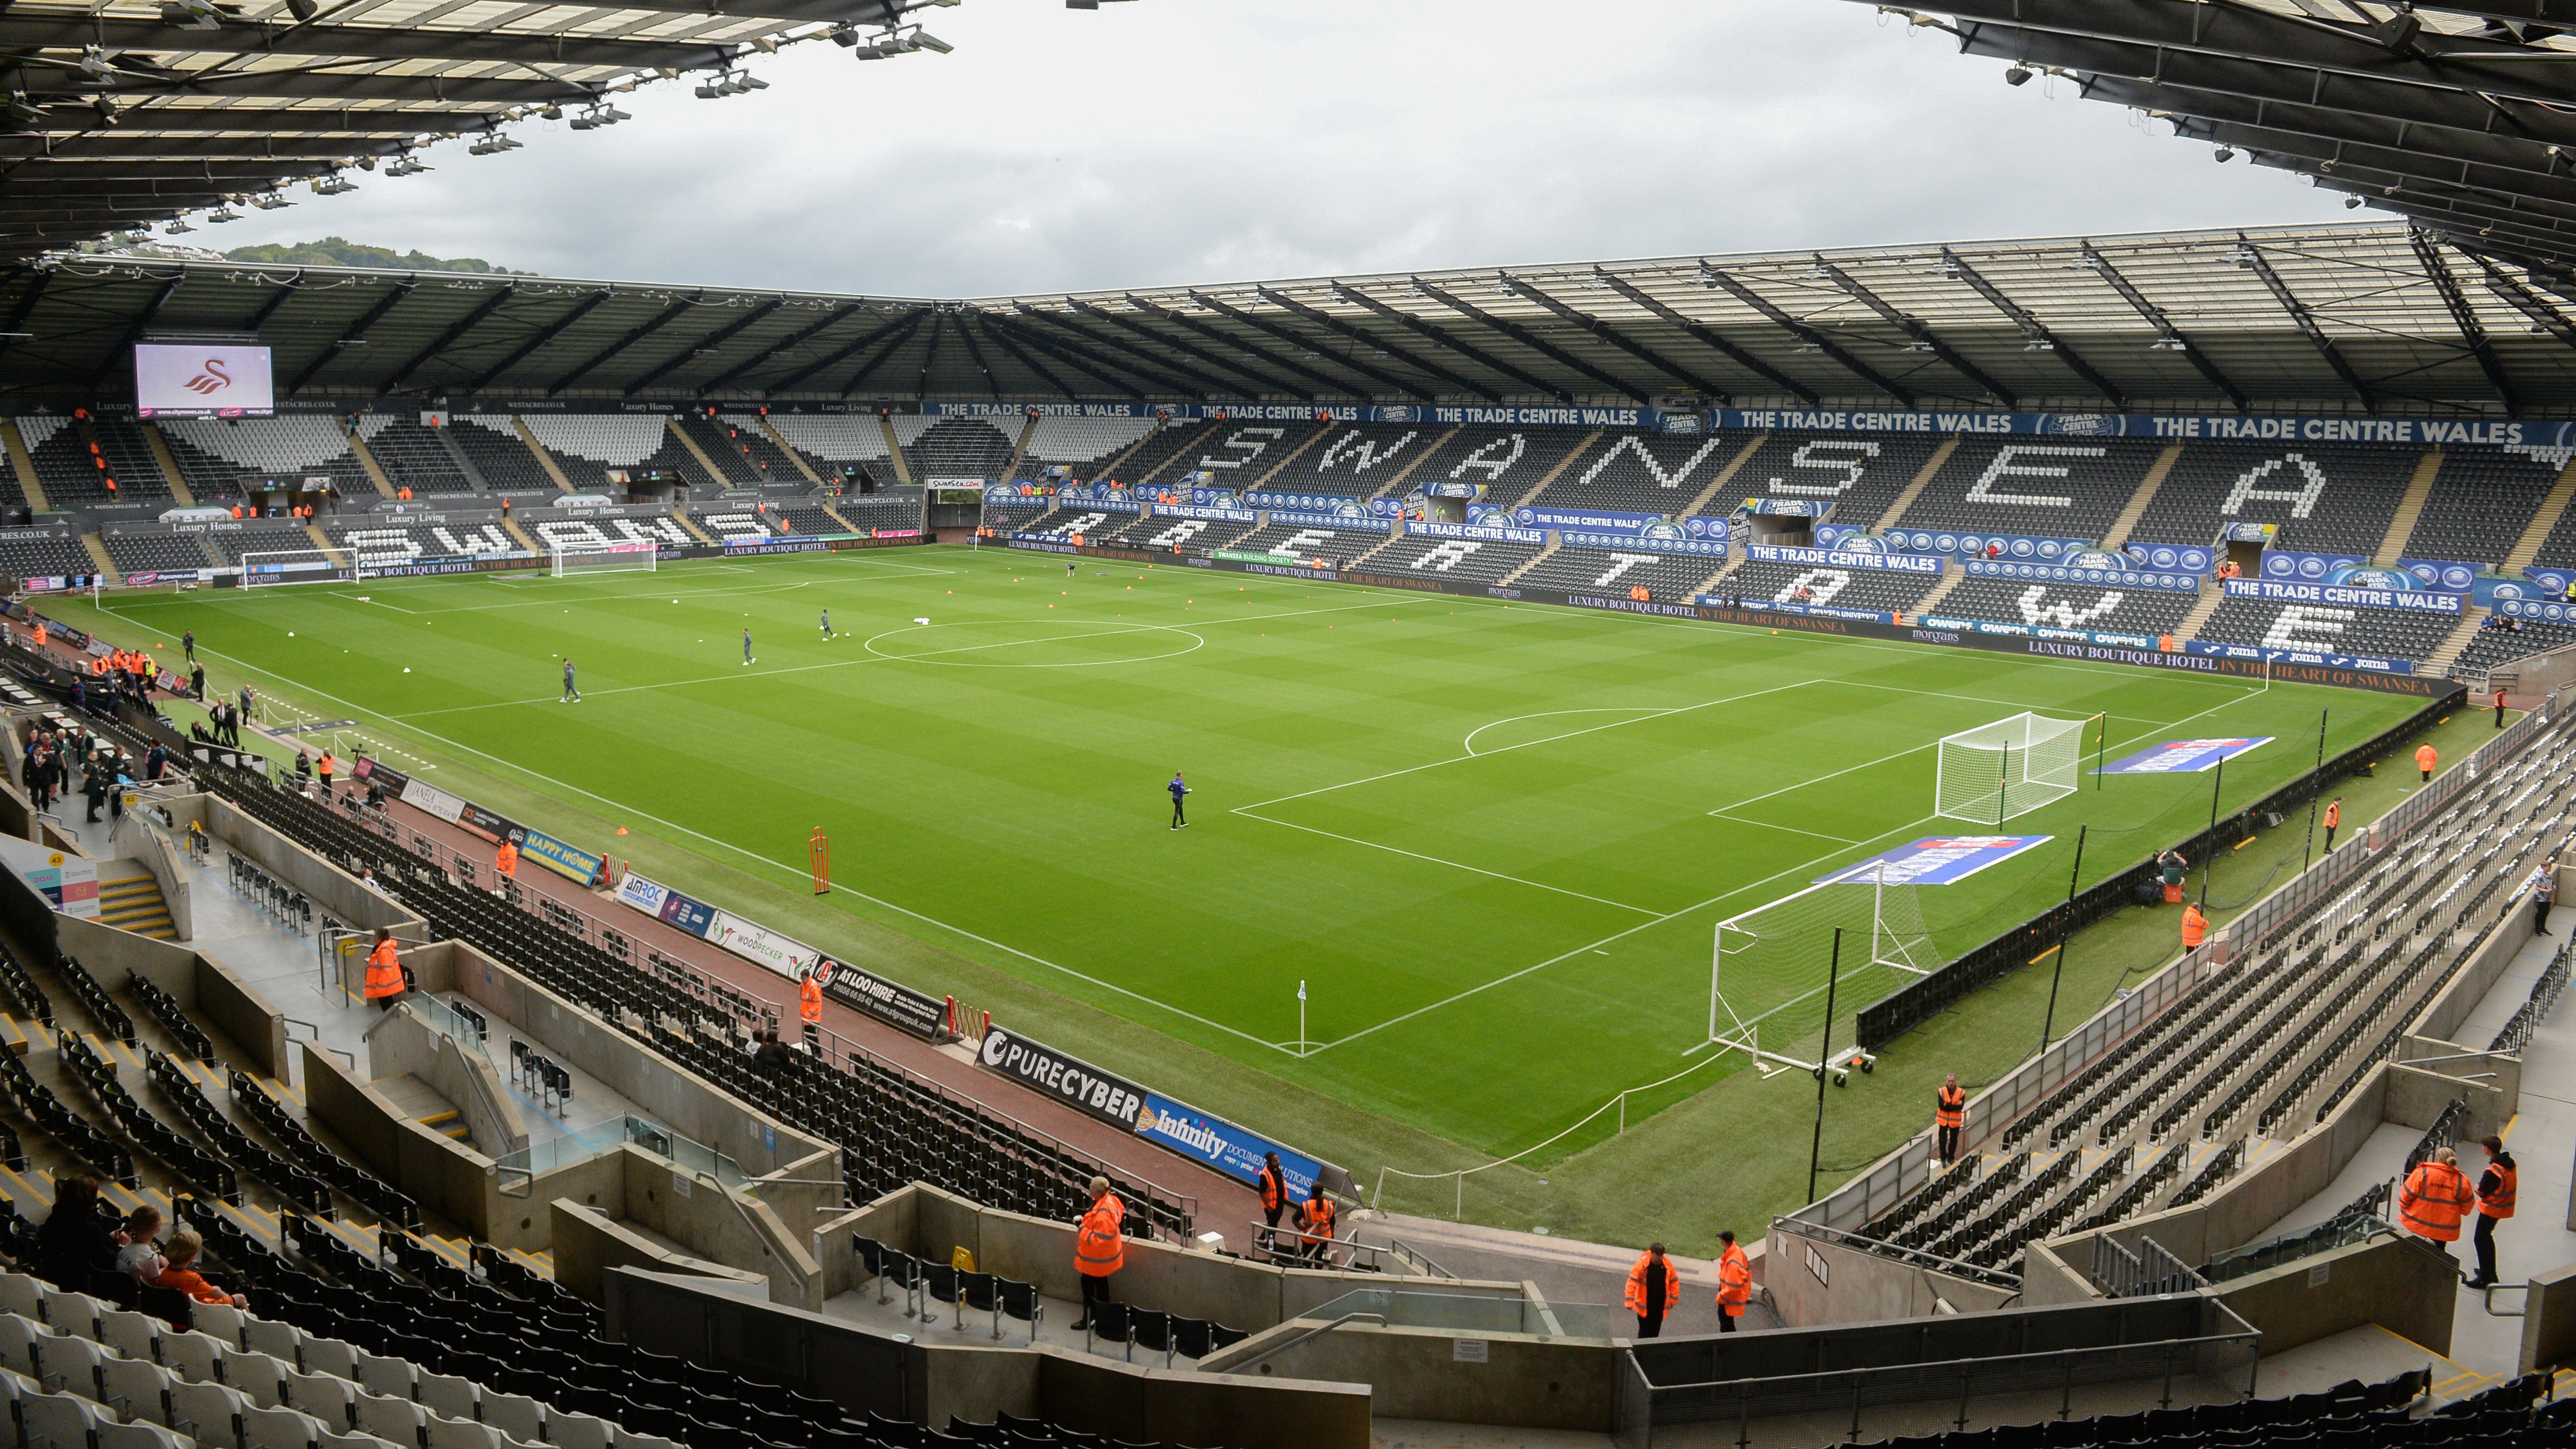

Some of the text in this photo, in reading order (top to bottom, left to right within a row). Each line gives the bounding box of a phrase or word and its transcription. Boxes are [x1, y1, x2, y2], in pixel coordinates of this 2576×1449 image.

[97, 401, 133, 411] Luxury
[822, 404, 845, 412] Luxury
[940, 404, 968, 416] THE
[971, 405, 1021, 416] TRADE
[1090, 405, 1131, 417] WALES
[1202, 406, 1222, 418] THE
[1225, 406, 1263, 419] TRADE
[1266, 406, 1311, 419] CENTRE
[1436, 408, 1638, 426] THE TRADE CENTRE WALES
[1668, 419, 1696, 428] CENTRE
[1741, 411, 2012, 433] THE TRADE CENTRE WALES
[2062, 421, 2099, 432] CENTRE
[2153, 417, 2523, 444] THE TRADE CENTRE WALES
[386, 513, 446, 524] Luxury Living
[568, 508, 594, 517] Luxury
[1154, 504, 1254, 521] THE TRADE CENTRE WALES
[1775, 505, 1801, 515] CENTRE
[173, 522, 243, 533] Luxury Homes
[1537, 514, 1642, 528] THE TRADE CENTRE WALES
[1409, 522, 1542, 542] THE TRADE CENTRE WALES
[724, 546, 759, 556] LUXURY
[759, 544, 800, 554] BOUTIQUE
[801, 543, 827, 551] HOTEL
[1009, 540, 1029, 549] LUXURY
[1030, 542, 1057, 553] BOUTIQUE
[1057, 544, 1078, 554] HOTEL
[1098, 548, 1117, 558] HEART
[1118, 550, 1125, 559] OF
[1125, 552, 1154, 562] SWANSEA
[385, 565, 439, 577] BOUTIQUE
[441, 562, 475, 573] HOTEL
[476, 561, 486, 570] IN
[509, 558, 542, 568] HEART
[1188, 558, 1212, 568] morgans
[1268, 556, 1291, 564] SOCIETY
[1753, 546, 1936, 572] THE TRADE CENTRE WALES
[157, 571, 198, 581] citymoves.co.uk
[1246, 564, 1442, 591] LUXURY BOUTIQUE HOTEL IN THE HEART OF SWANSEA
[1488, 587, 1521, 599] morgans
[2228, 581, 2458, 611] THE TRADE CENTRE WALES
[1569, 595, 1846, 633] LUXURY BOUTIQUE HOTEL IN THE HEART OF SWANSEA
[1809, 608, 1840, 617] SWANSEA
[1841, 611, 1880, 621] UNIVERSITY
[1927, 618, 1973, 630] owens
[1913, 629, 1959, 643] morgans
[2029, 641, 2432, 695] LUXURY BOUTIQUE HOTEL IN THE HEART OF SWANSEA
[412, 783, 436, 804] JANELA
[527, 834, 562, 858] HAPPY
[561, 850, 596, 872] HOME
[626, 877, 662, 902] AMROC
[738, 934, 783, 961] WOODPECKER
[819, 960, 834, 983] A1
[837, 969, 896, 1003] A1 LOO HIRE
[832, 982, 934, 1033] 01656 66 55 42 www.a1groupuk.com
[1005, 1043, 1141, 1123] PURECYBER
[1155, 1109, 1228, 1160] Infinity
[1224, 1155, 1254, 1172] copy print
[1227, 1143, 1313, 1188] DOCUMEN LUTIONS
[1283, 1180, 1308, 1196] hnologies
